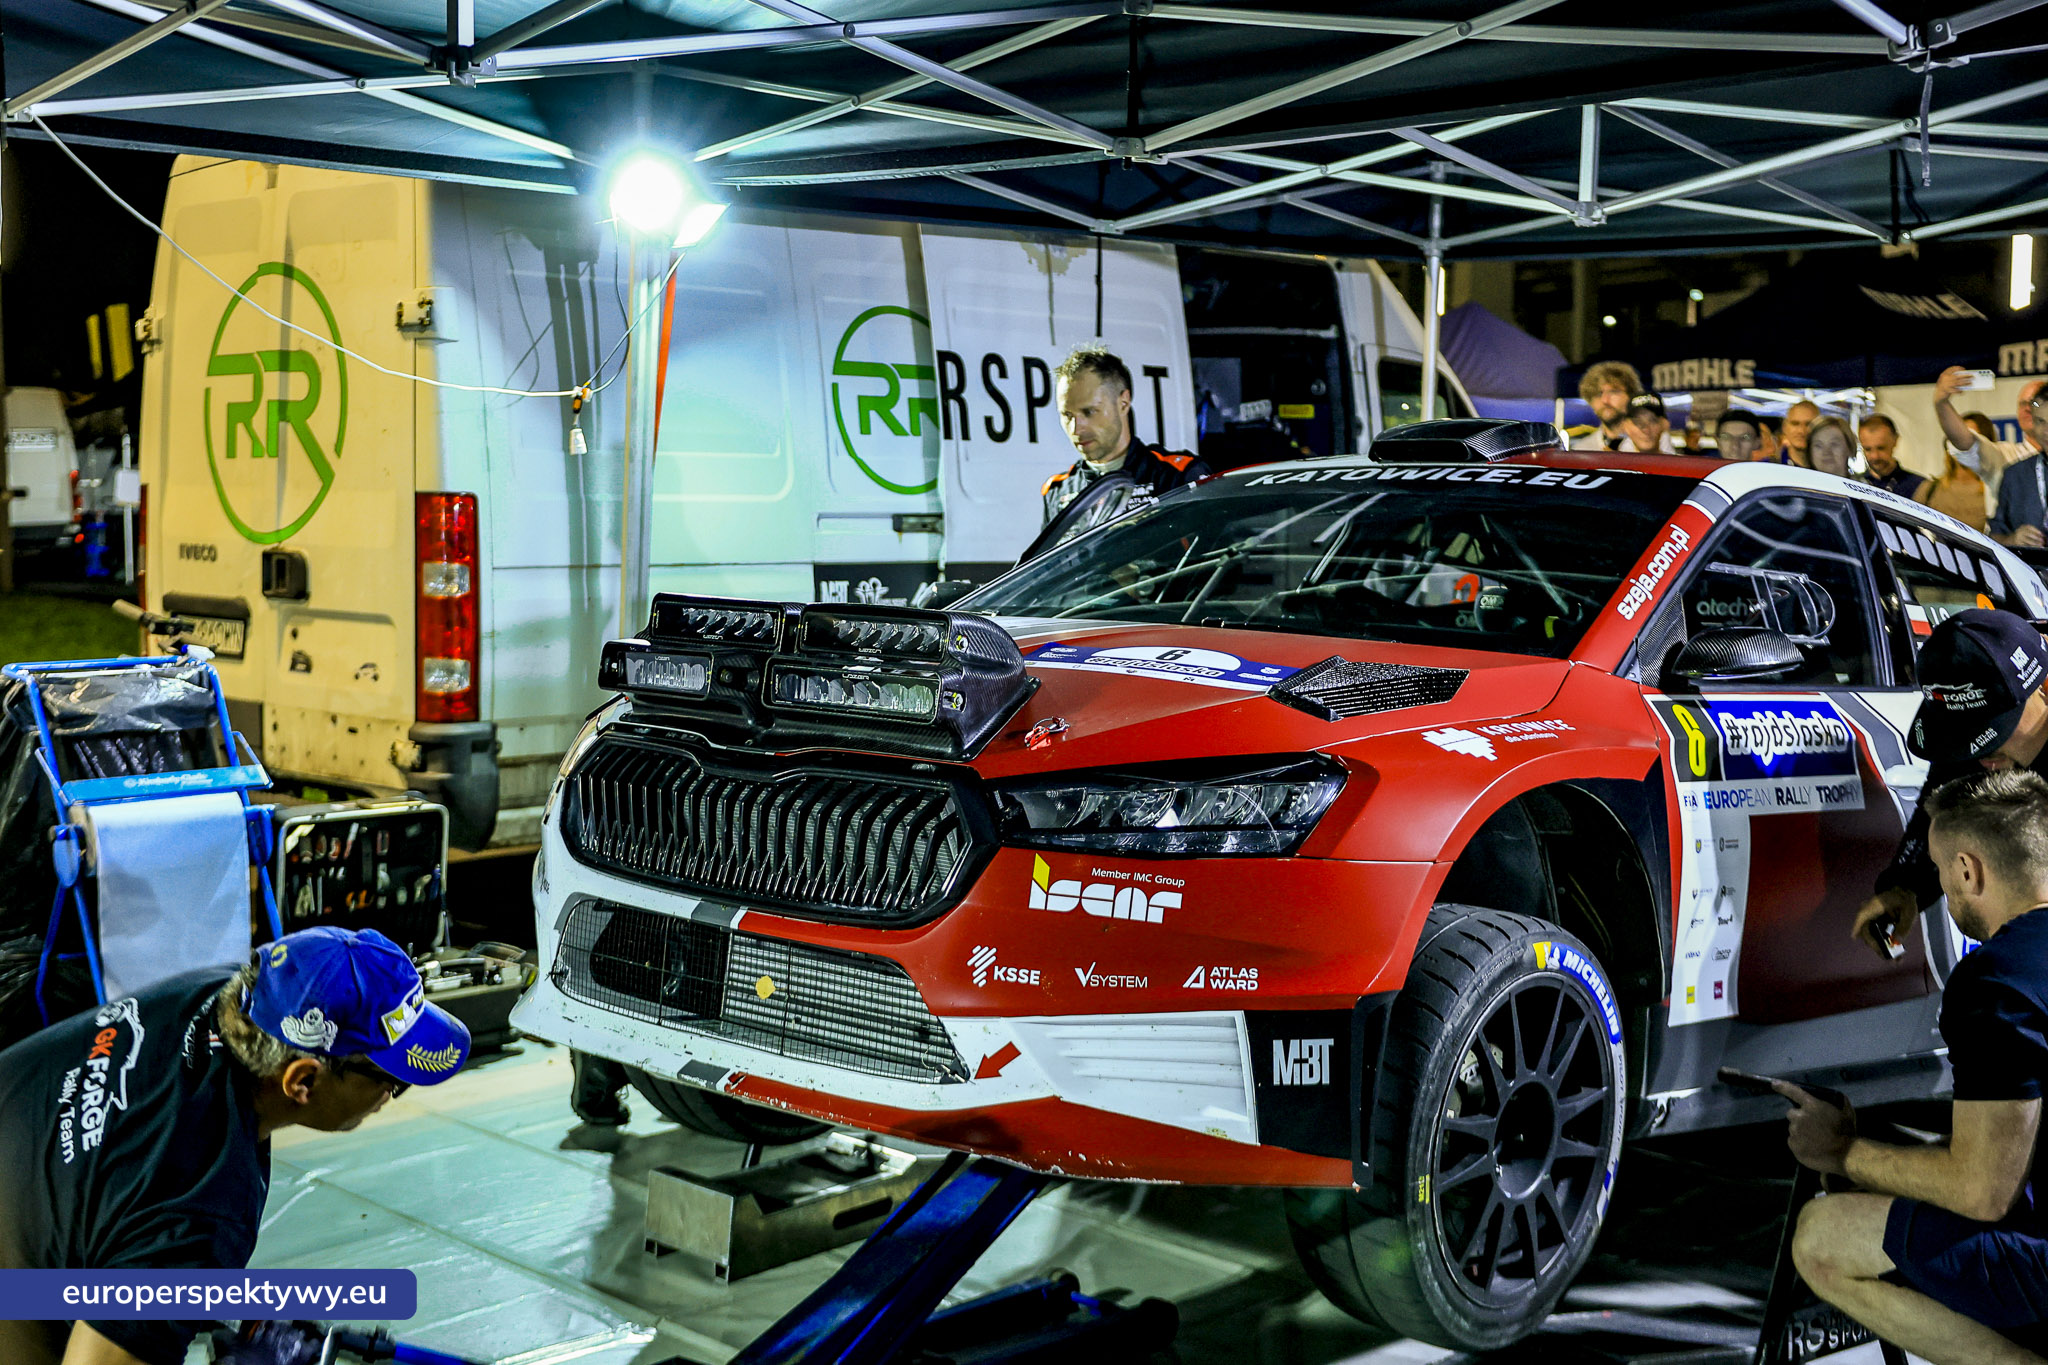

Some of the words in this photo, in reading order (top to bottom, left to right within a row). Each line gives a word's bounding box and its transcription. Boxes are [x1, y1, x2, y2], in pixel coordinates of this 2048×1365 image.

[1652, 359, 1756, 391] MAHLE
[937, 349, 1169, 448] RSPT
[1245, 467, 1613, 490] KATOWICE.EU
[179, 542, 217, 562] IVECO
[1616, 523, 1691, 621] szeja.com.pl
[1156, 649, 1191, 661] 6
[1477, 719, 1576, 736] KATOWICE
[1724, 714, 1846, 758] #rajdslaska
[1703, 786, 1772, 809] EUROPEAN
[1775, 784, 1812, 806] RALLY
[1816, 784, 1859, 804] TROPHY
[1029, 854, 1183, 924] iscar
[1092, 867, 1131, 880] Member
[1134, 871, 1152, 883] IMC
[1154, 875, 1185, 888] Group
[993, 965, 1041, 986] KSSE
[1210, 966, 1259, 979] ATLAS
[1210, 978, 1259, 991] WARD
[1562, 949, 1620, 1036] MICHELIN
[1273, 1038, 1334, 1086] MBT
[58, 1067, 81, 1104] Rally
[60, 1106, 75, 1164] Team
